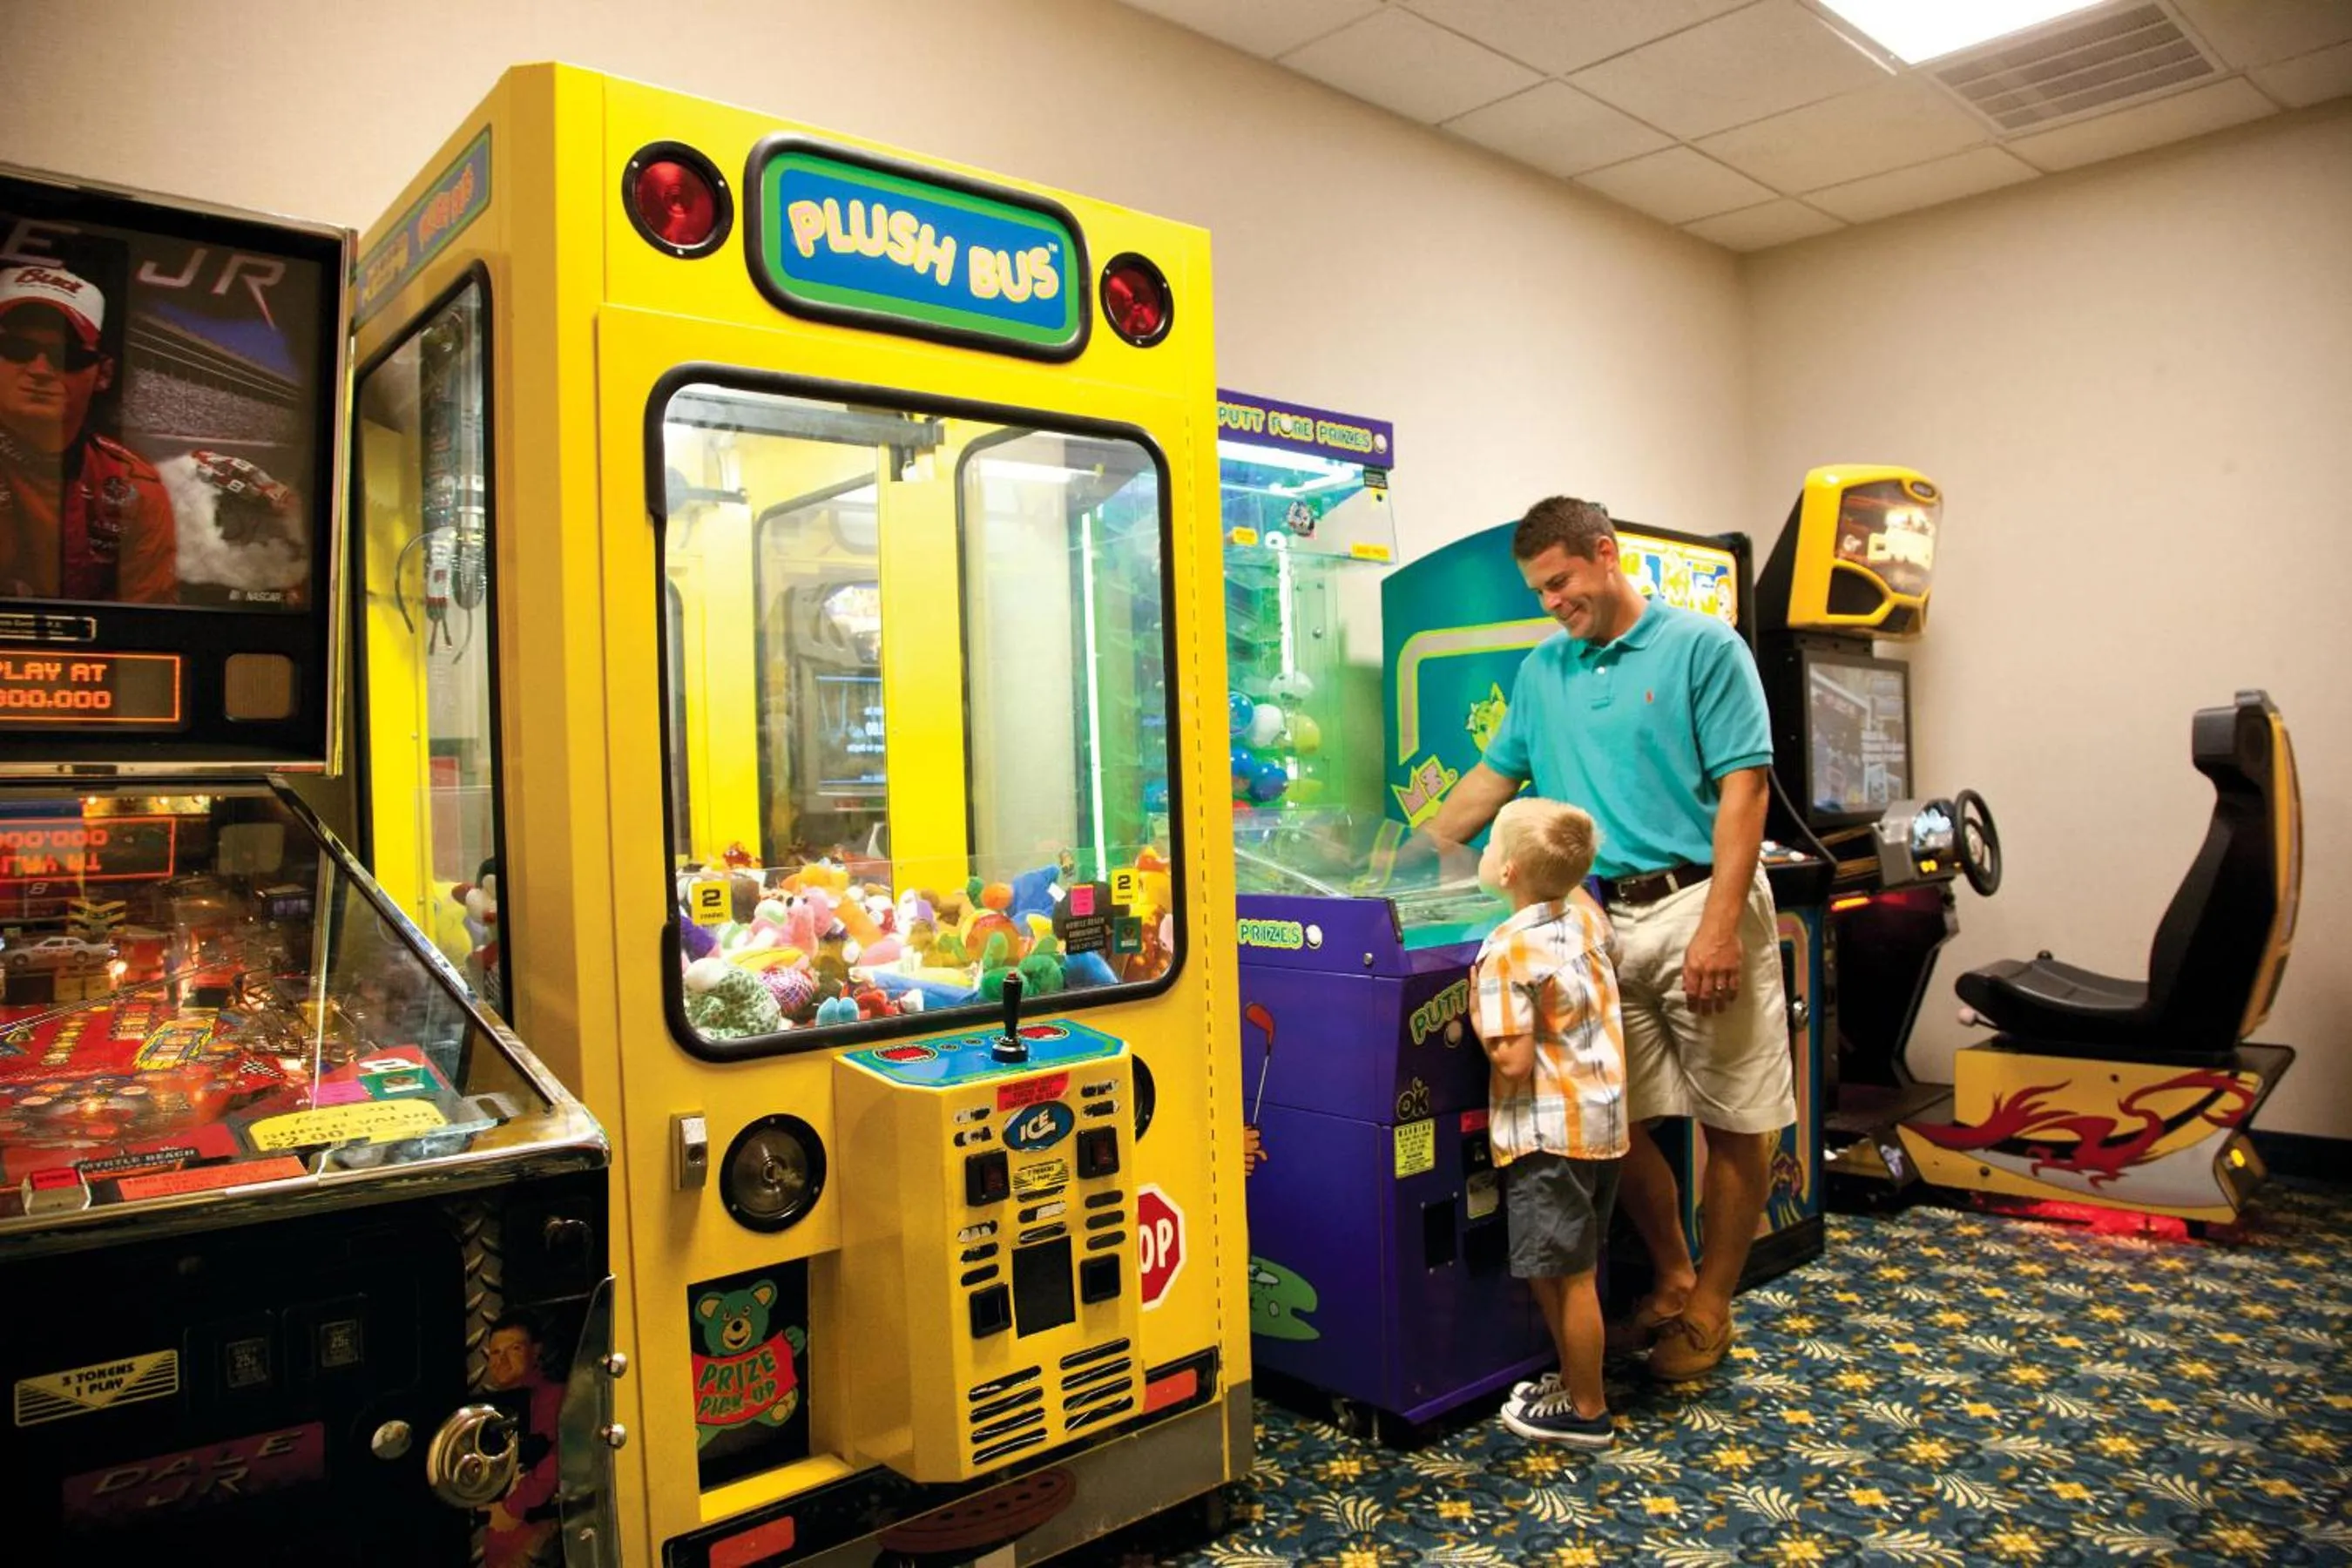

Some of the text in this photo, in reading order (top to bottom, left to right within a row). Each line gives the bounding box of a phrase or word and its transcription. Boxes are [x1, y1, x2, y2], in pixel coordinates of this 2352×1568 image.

[788, 198, 957, 287] PLUSH
[968, 246, 1058, 302] BUS
[138, 247, 286, 330] JR
[1218, 402, 1265, 432] PUTT
[1317, 421, 1372, 452] PRIZES
[71, 663, 107, 682] AT
[1118, 875, 1131, 889] 2
[702, 889, 721, 907] 2
[1238, 920, 1302, 948] PRIZES
[1410, 979, 1469, 1044] PUTT
[1020, 1108, 1056, 1142] ICE
[76, 1362, 135, 1383] TOKENS
[698, 1347, 778, 1391] PRIZE
[89, 1377, 124, 1395] PLAY
